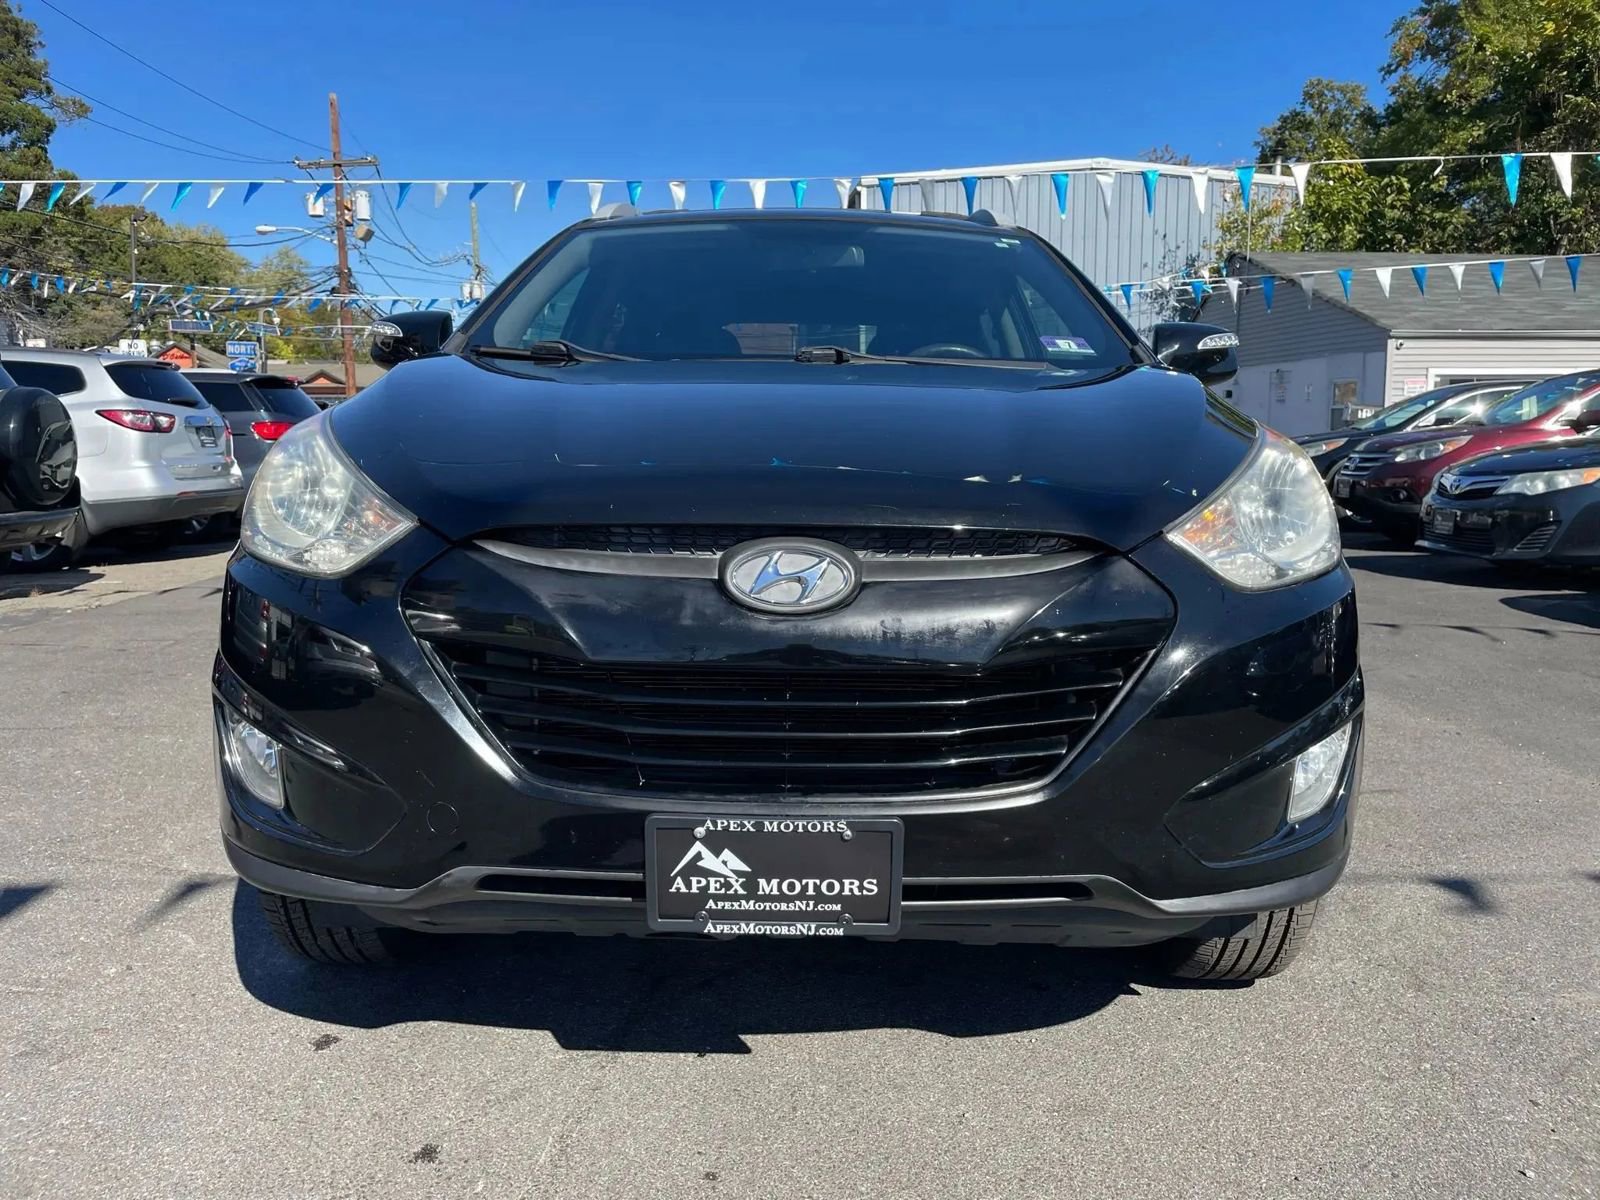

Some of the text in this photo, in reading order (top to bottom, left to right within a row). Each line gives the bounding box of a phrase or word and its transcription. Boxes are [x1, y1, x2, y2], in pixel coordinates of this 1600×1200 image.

[127, 342, 139, 350] NO
[703, 819, 848, 833] APEX MOTORS
[669, 876, 878, 896] APEX MOTORS
